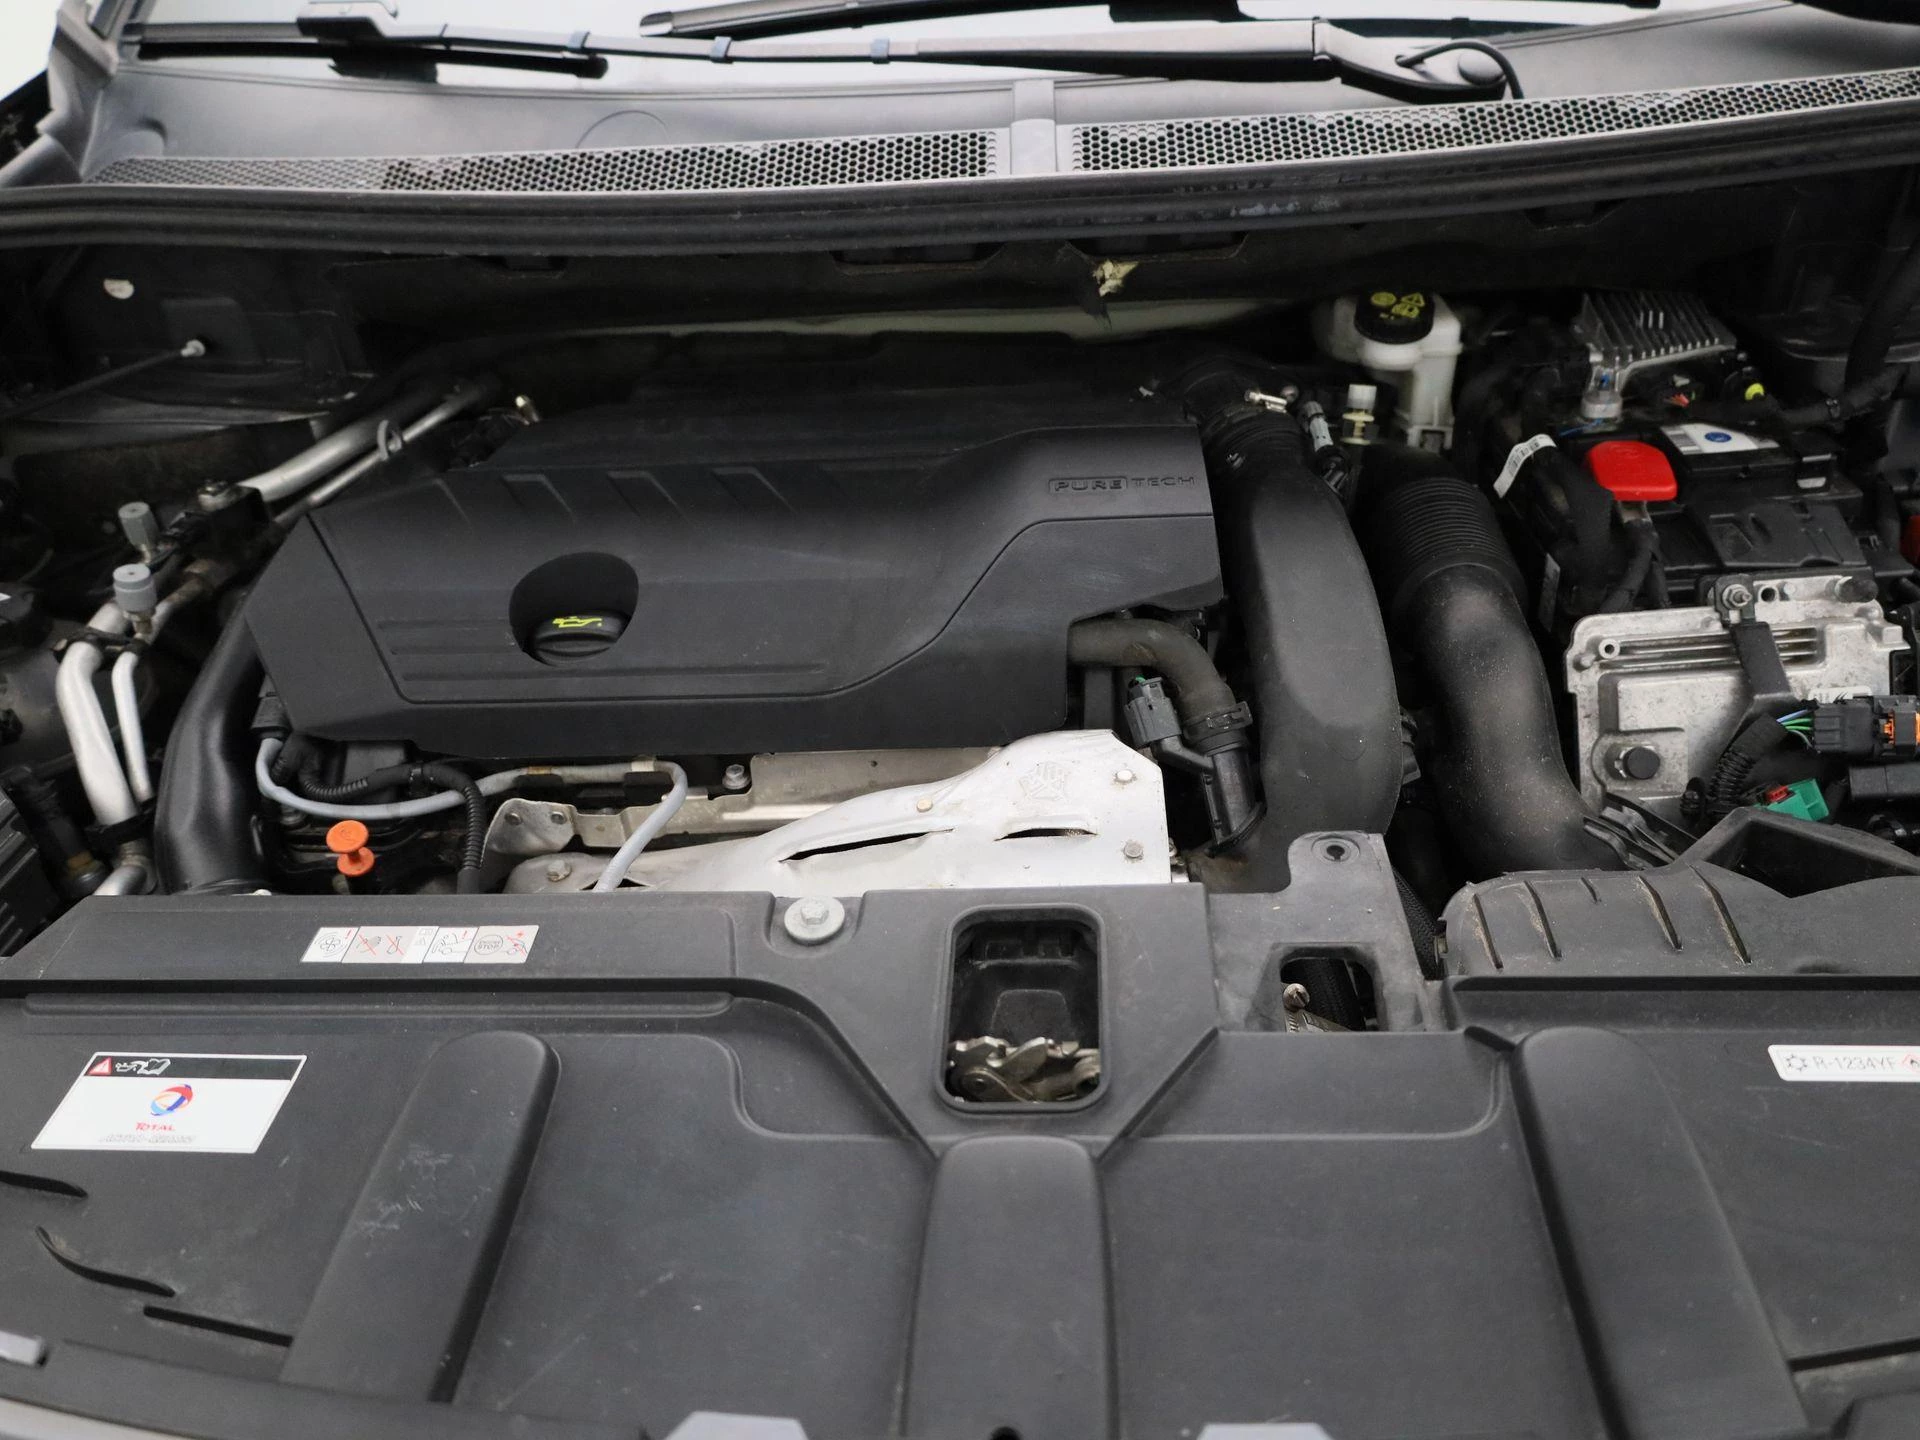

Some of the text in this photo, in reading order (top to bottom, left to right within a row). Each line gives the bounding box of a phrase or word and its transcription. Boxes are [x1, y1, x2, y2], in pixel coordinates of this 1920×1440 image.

[1054, 476, 1195, 491] PURE TECH
[135, 1122, 176, 1131] TOTAL
